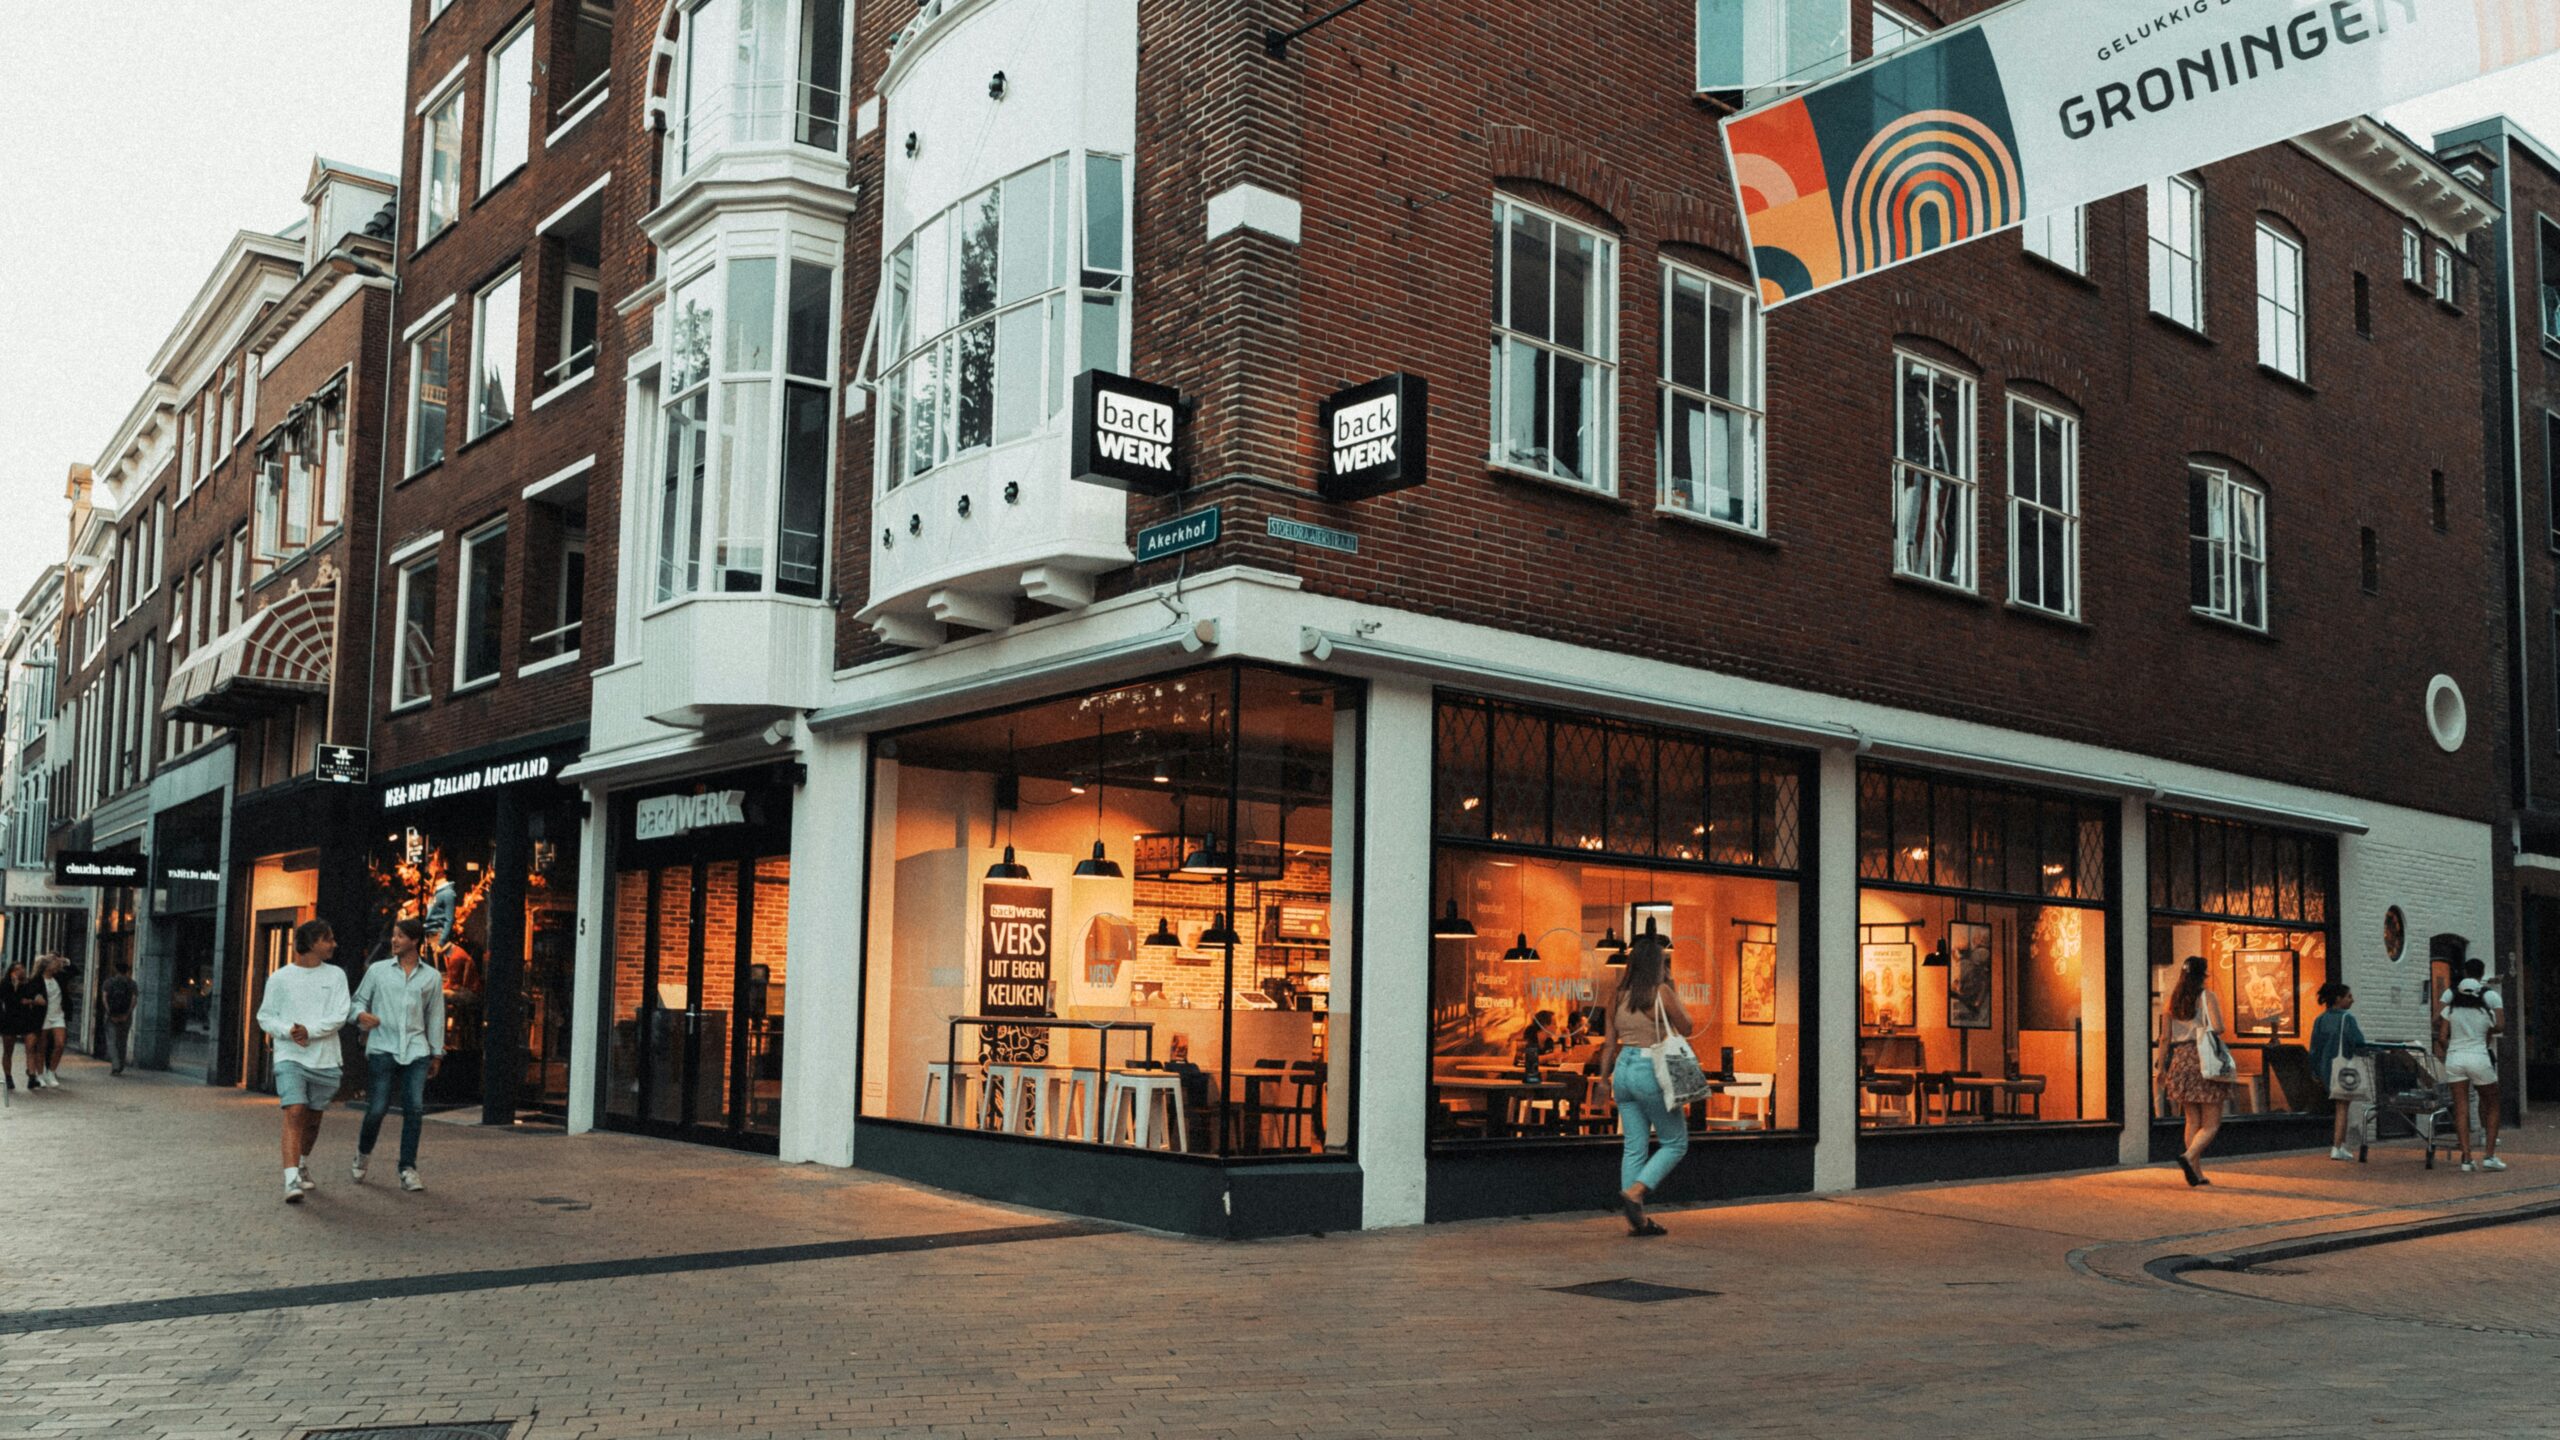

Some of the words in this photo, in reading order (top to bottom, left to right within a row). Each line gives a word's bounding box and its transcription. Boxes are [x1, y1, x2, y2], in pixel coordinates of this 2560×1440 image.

[2097, 0, 2209, 61] GELUKKIG
[1103, 396, 1168, 437] back
[1338, 402, 1392, 442] back
[1097, 430, 1172, 471] WERK
[1333, 435, 1396, 475] WERK
[1147, 519, 1207, 551] Akerkhof
[408, 782, 431, 803] NEW
[432, 771, 481, 798] ZEALAND
[484, 756, 549, 788] AUCKLAND
[10, 892, 52, 903] JUNIOR
[53, 893, 85, 904] SHOP
[579, 918, 586, 935] 5
[990, 922, 1046, 956] VERS
[989, 960, 1008, 978] UIT
[1012, 961, 1044, 979] EIGEN
[1089, 963, 1115, 989] VERS
[987, 984, 1044, 1006] KEUKEN
[1529, 975, 1594, 1002] VITAMINES
